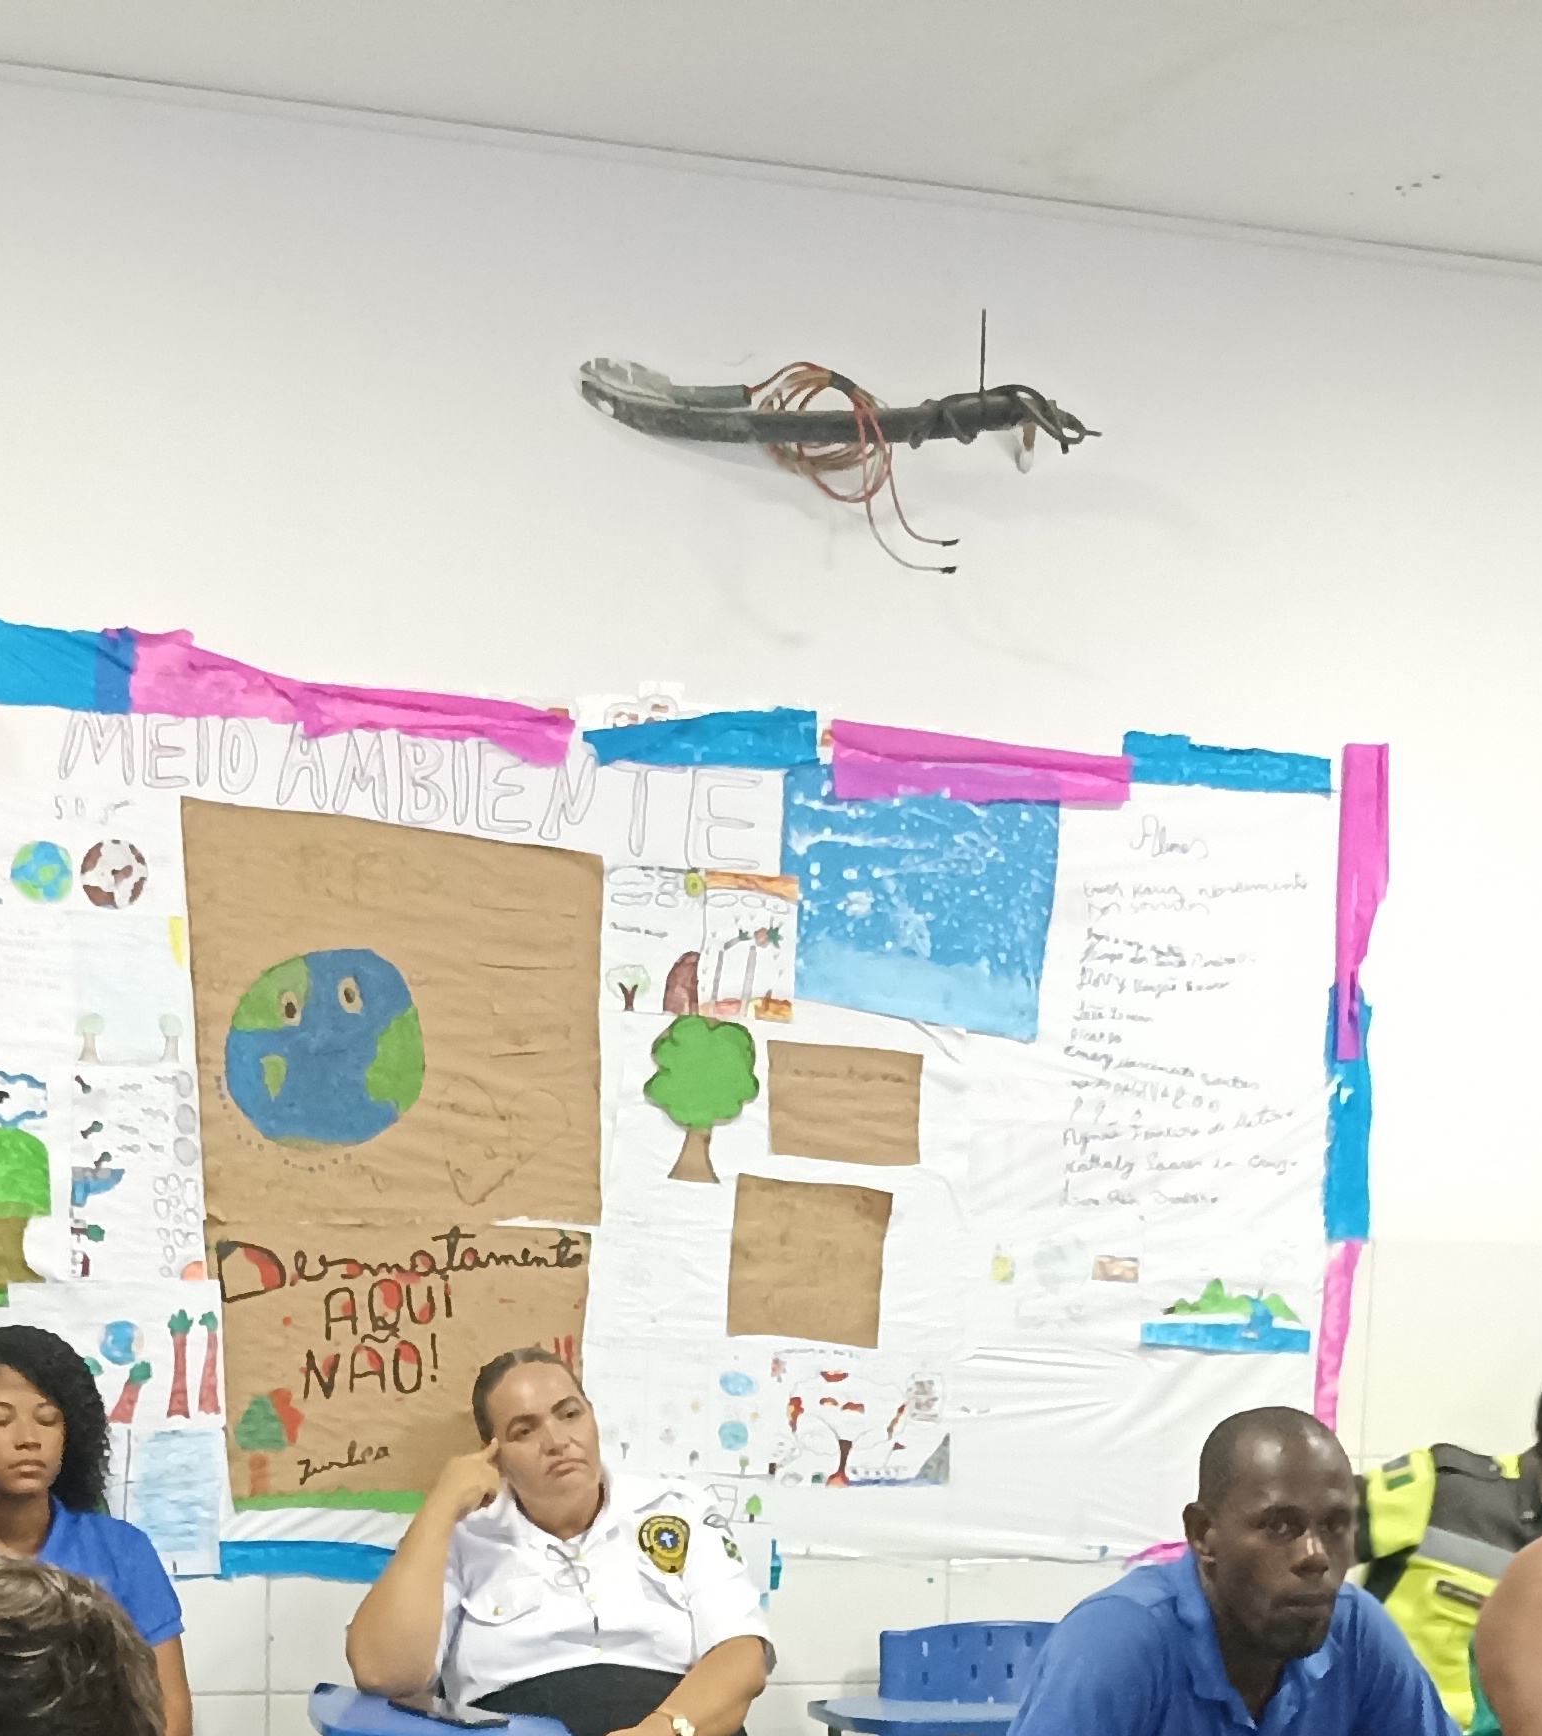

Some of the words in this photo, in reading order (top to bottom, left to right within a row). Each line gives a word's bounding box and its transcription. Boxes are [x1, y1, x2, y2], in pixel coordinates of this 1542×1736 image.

[58, 710, 258, 795] MEIO
[275, 719, 763, 870] AMBIENTE
[216, 1226, 583, 1304] Desmatamento
